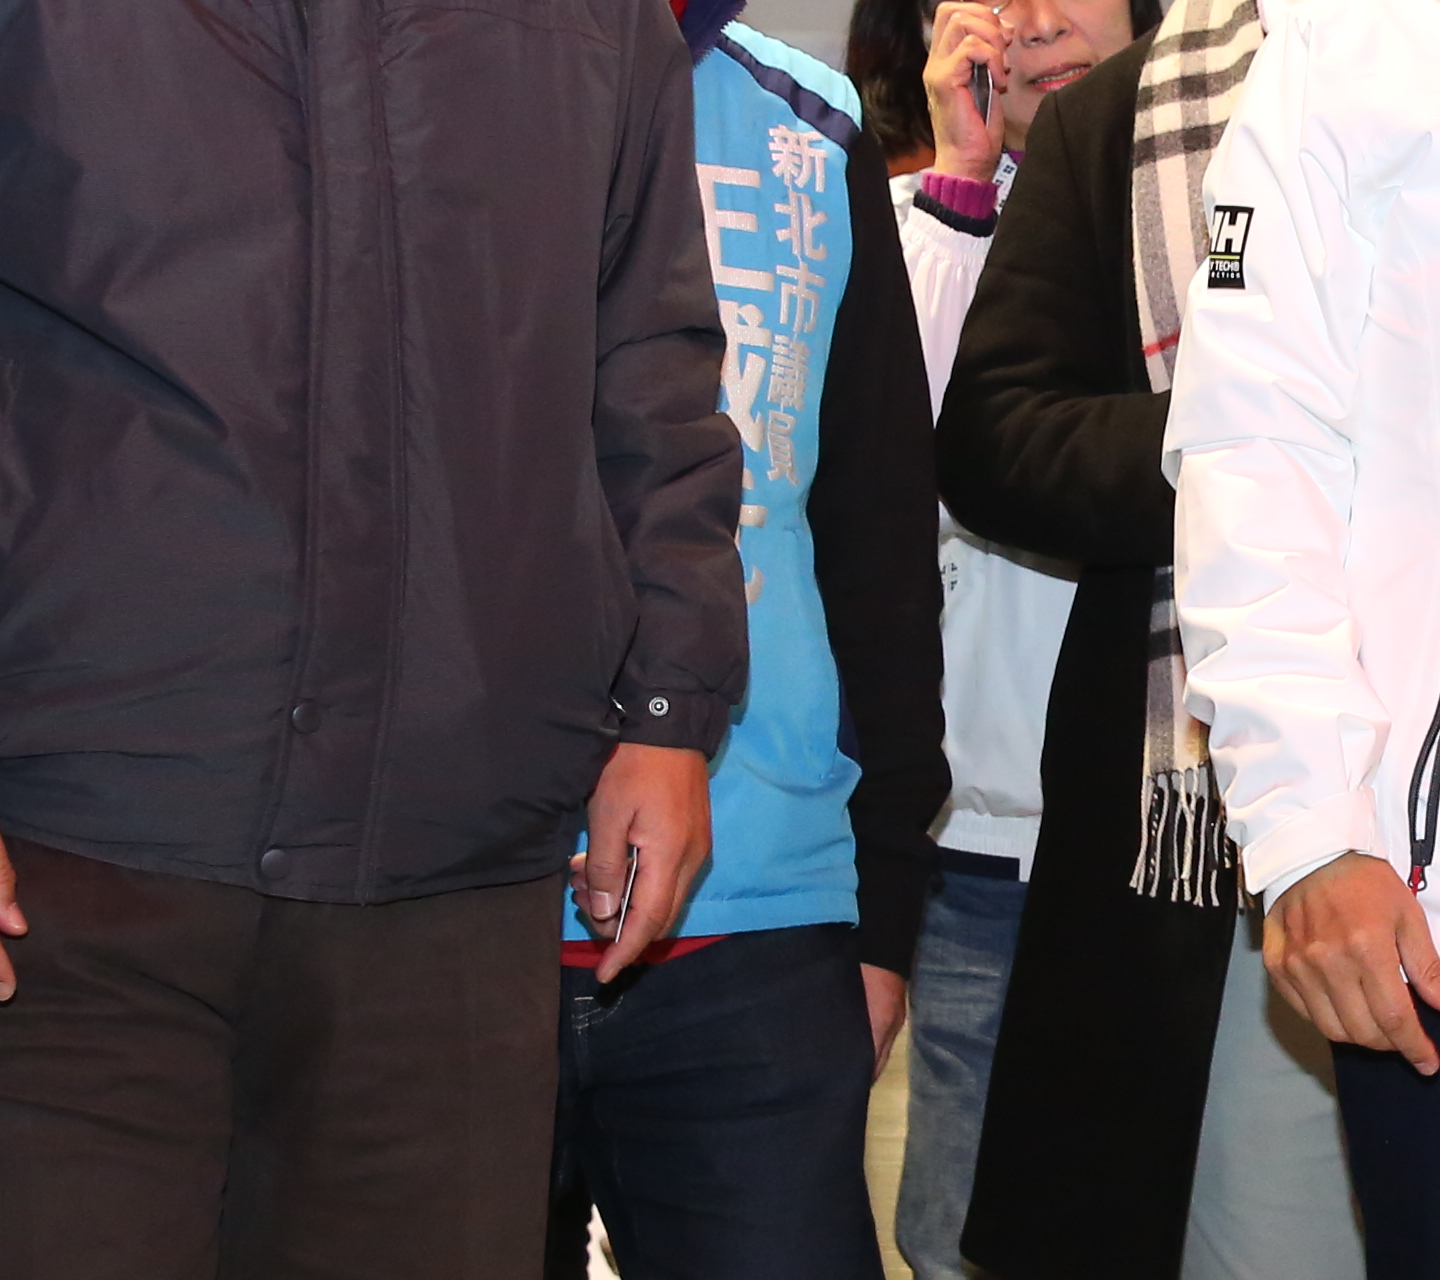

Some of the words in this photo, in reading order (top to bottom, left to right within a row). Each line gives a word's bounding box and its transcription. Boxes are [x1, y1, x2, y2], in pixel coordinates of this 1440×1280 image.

[766, 123, 828, 486] 新北市議員
